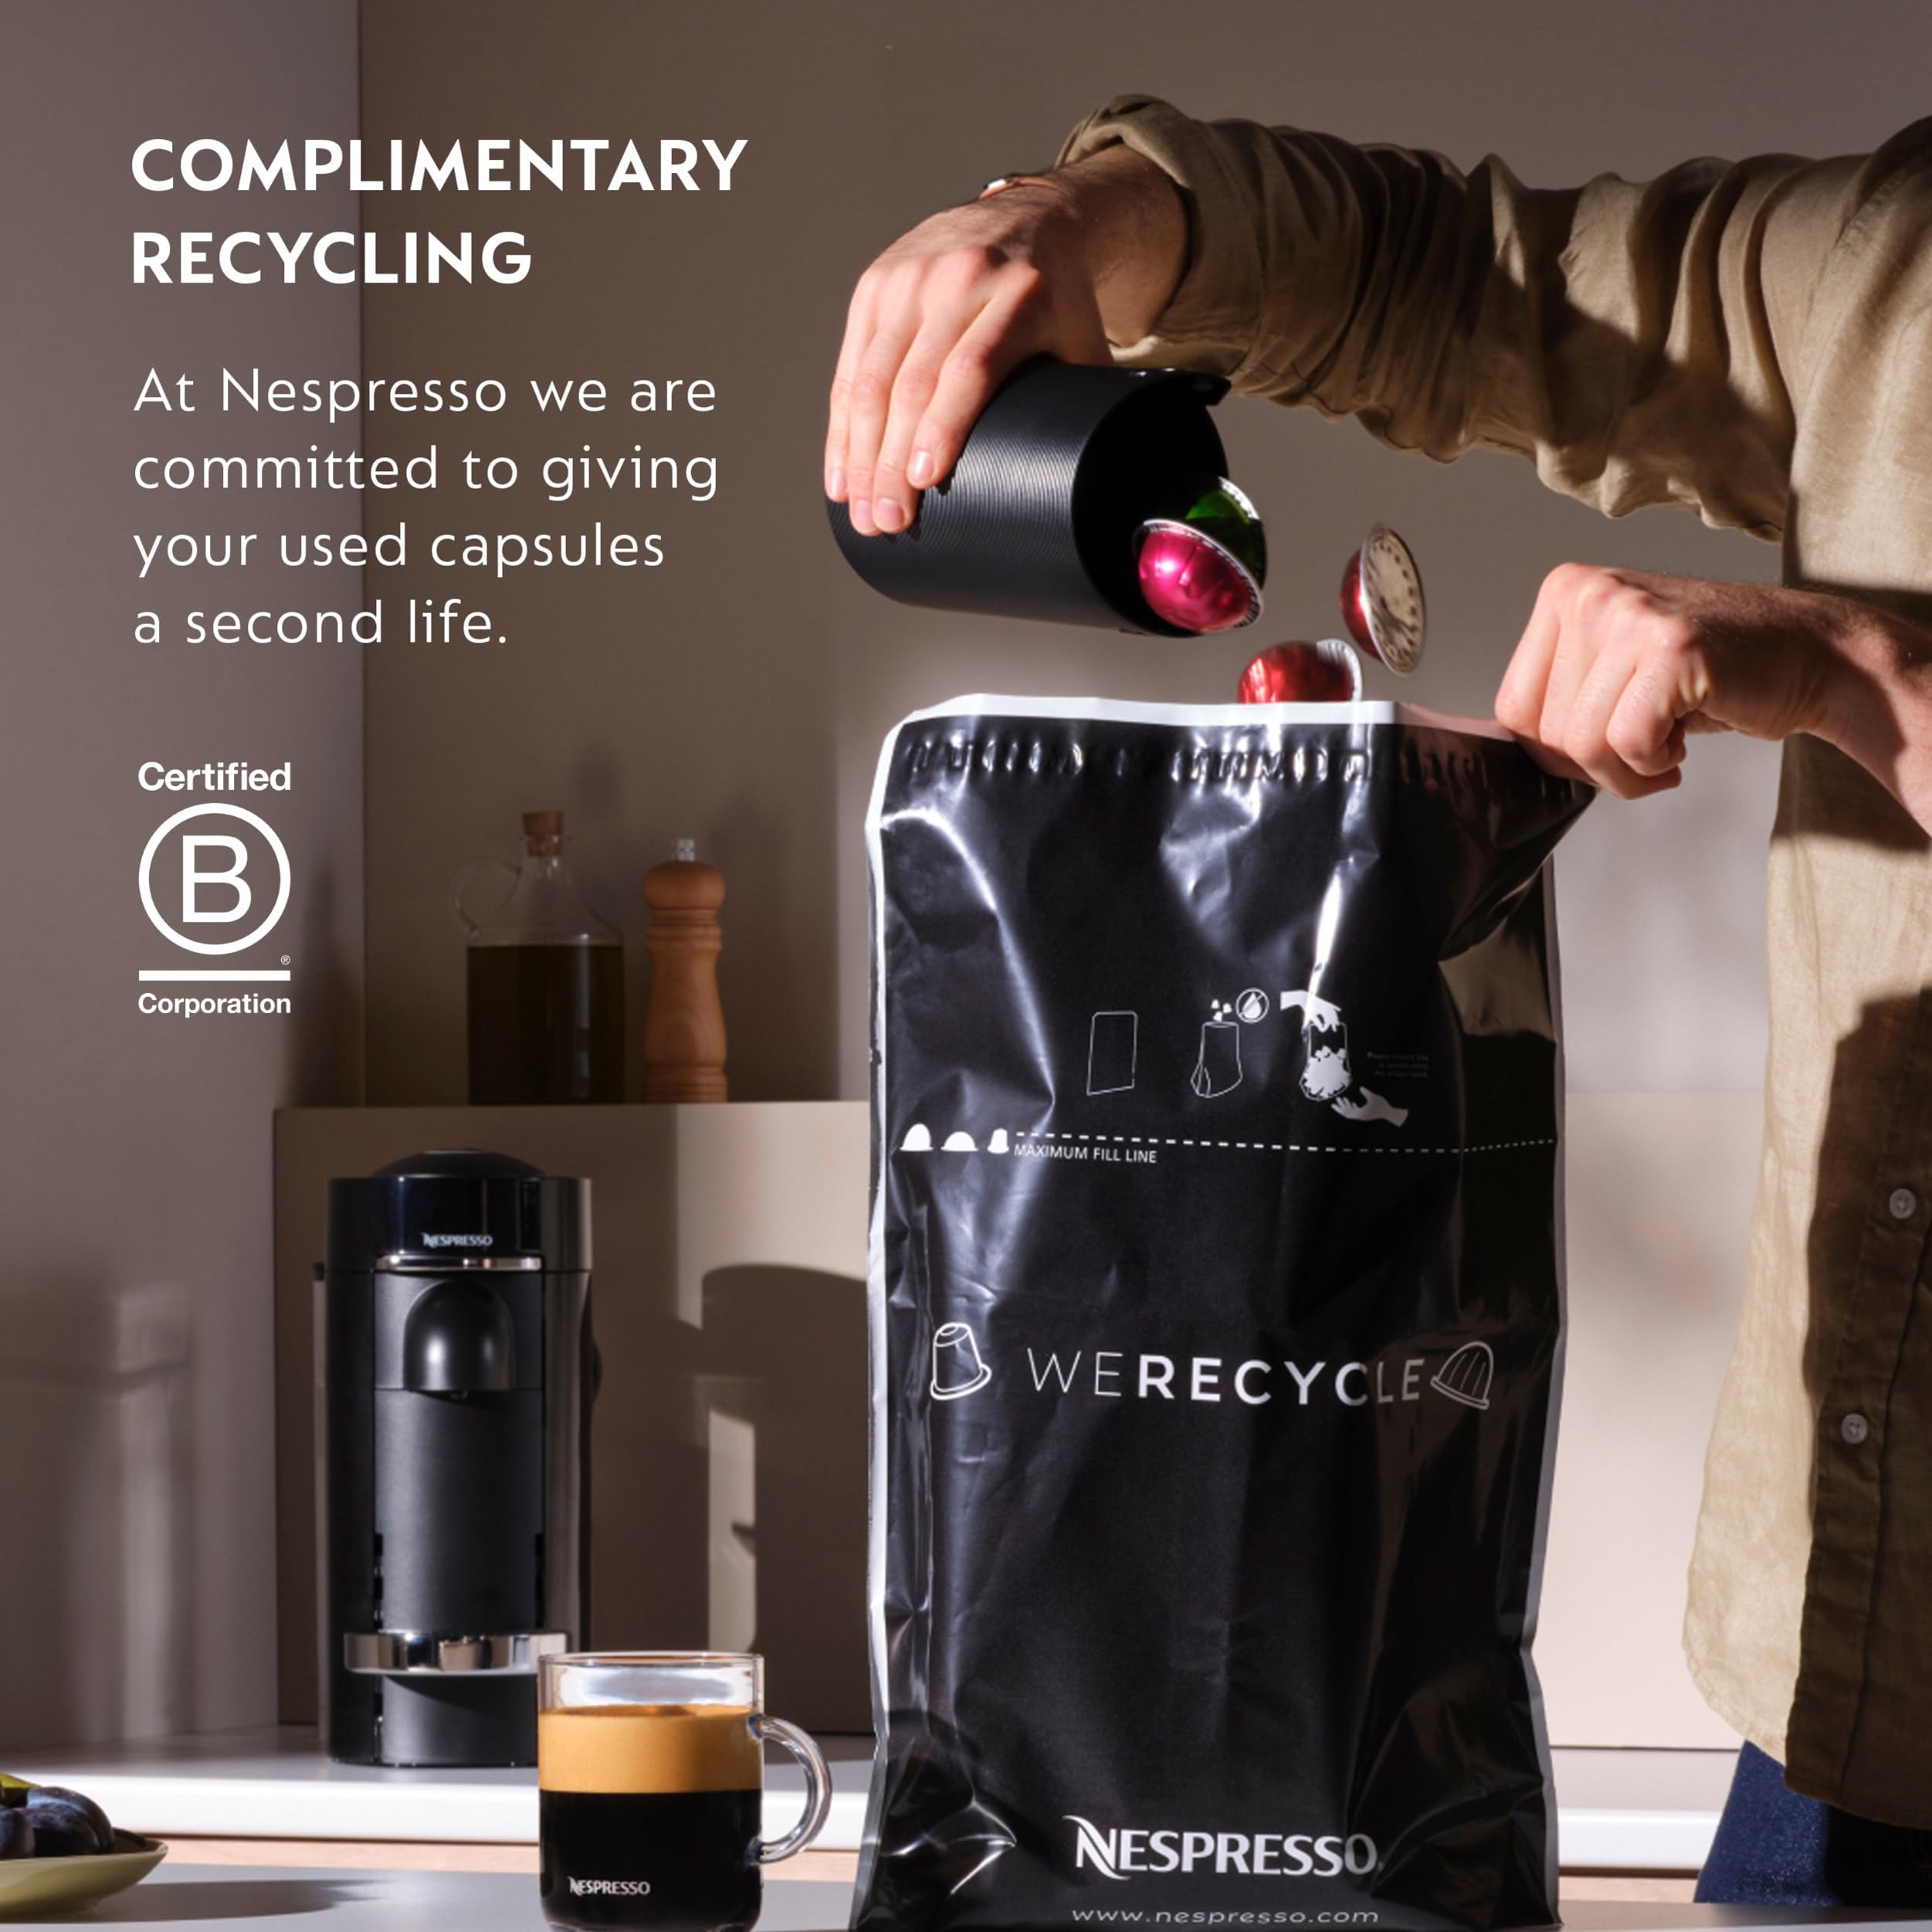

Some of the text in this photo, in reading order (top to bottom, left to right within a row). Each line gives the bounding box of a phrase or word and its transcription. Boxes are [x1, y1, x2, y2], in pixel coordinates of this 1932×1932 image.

[1014, 1144, 1158, 1163] MAXIMUM FILL LINE
[422, 1232, 493, 1249] NESPRESSO
[1063, 1815, 1378, 1881] NESPRESSO
[568, 1876, 651, 1896] NESPRESSO
[1072, 1909, 1379, 1925] www.nespresso.com
